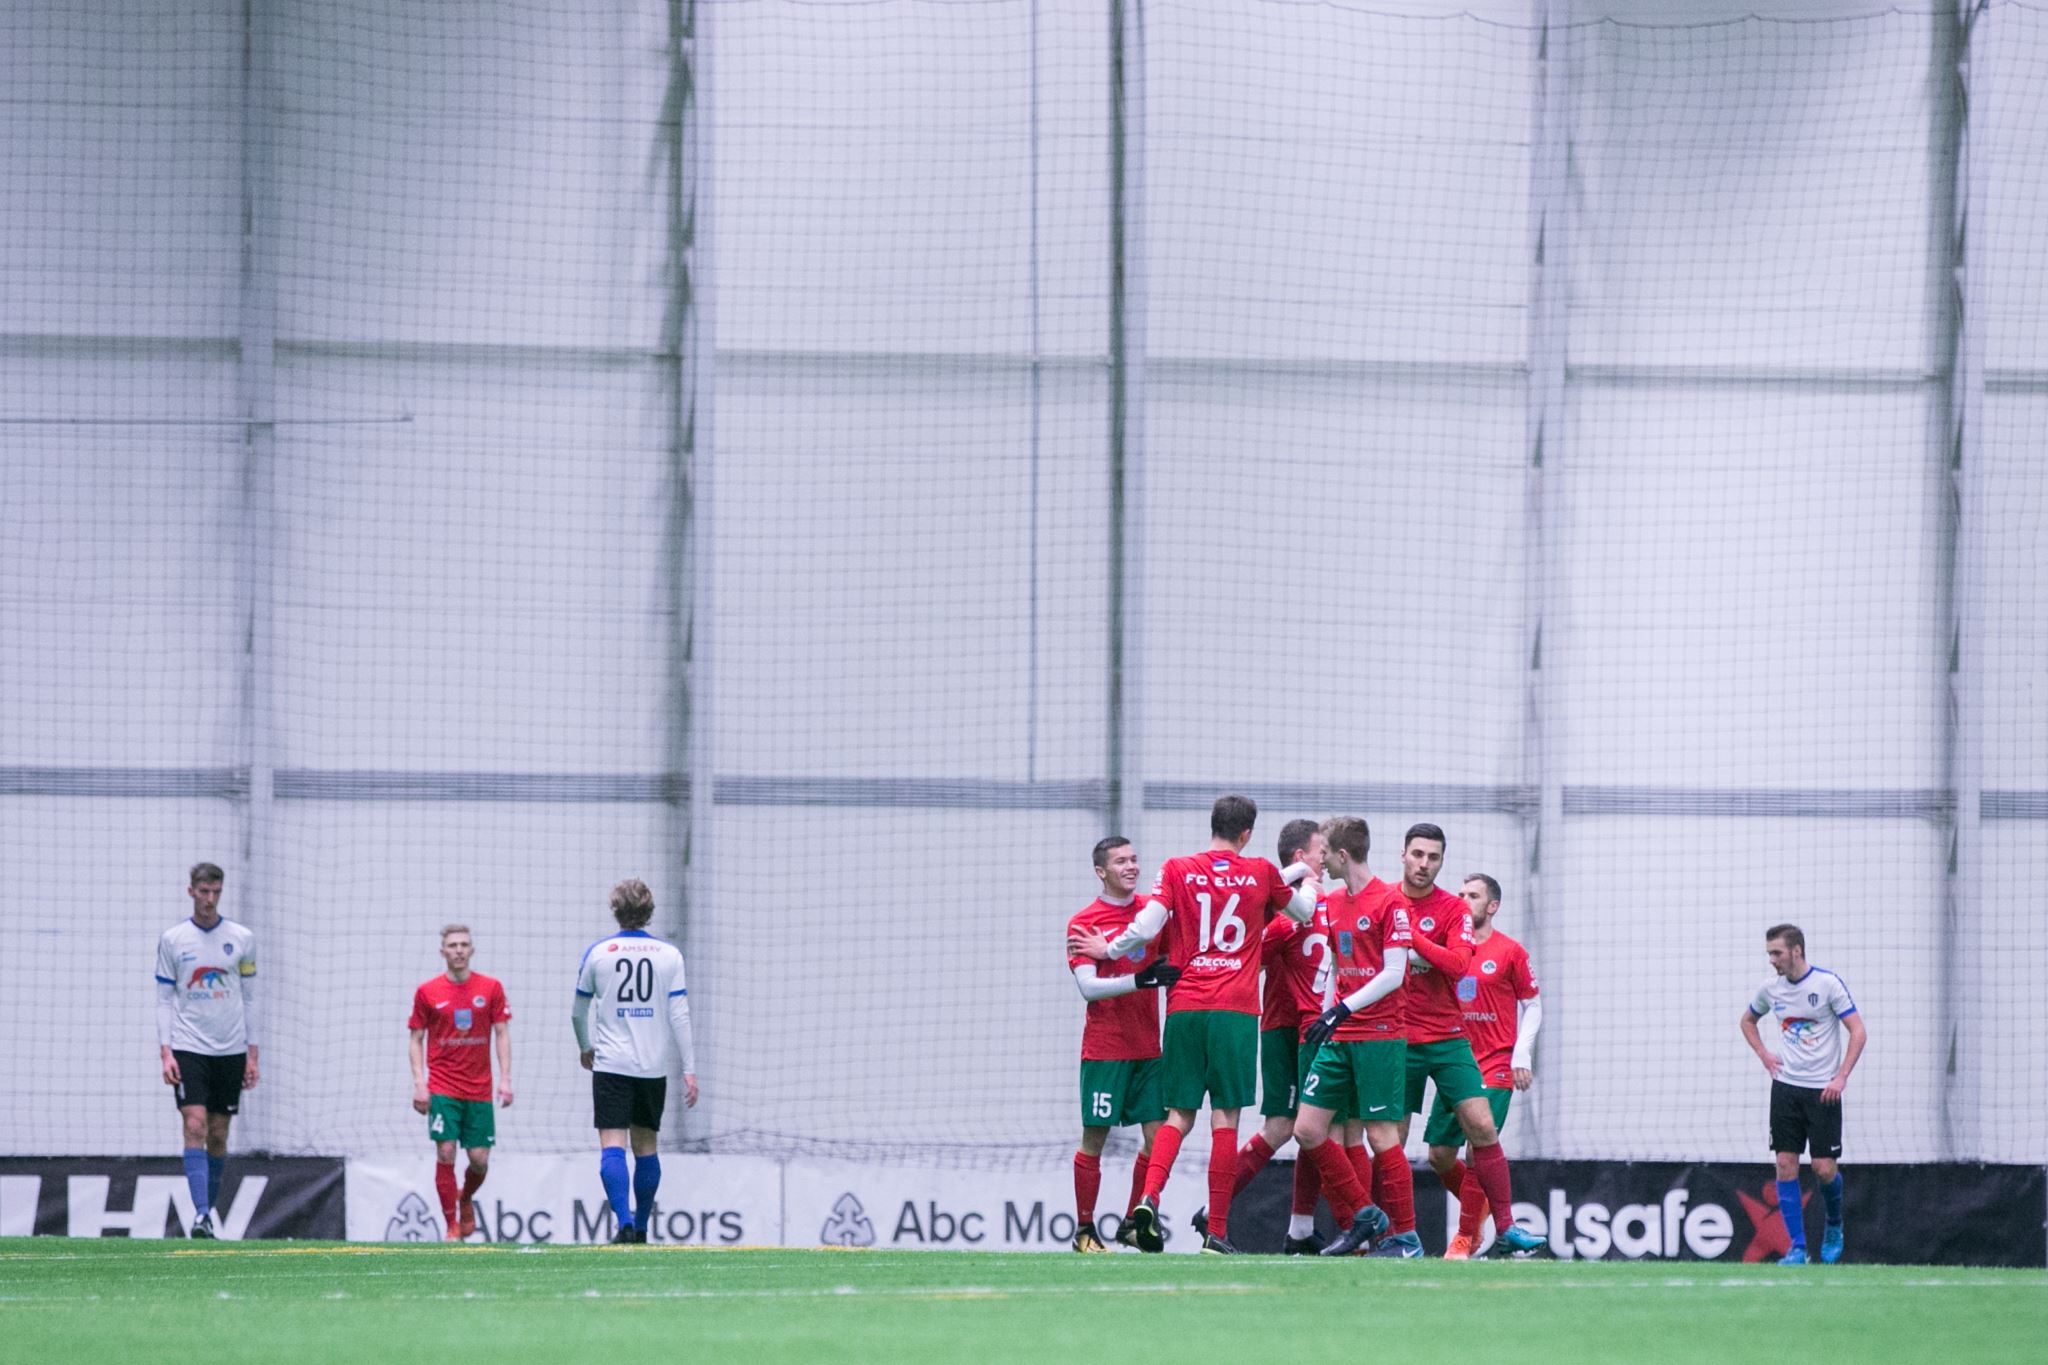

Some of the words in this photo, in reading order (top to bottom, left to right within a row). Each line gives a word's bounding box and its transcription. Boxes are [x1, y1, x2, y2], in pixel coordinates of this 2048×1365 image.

[1186, 873, 1208, 886] FC
[1214, 875, 1257, 887] ELVA
[1196, 892, 1246, 953] 16
[616, 957, 653, 1003] 20
[431, 1113, 445, 1133] 4
[1093, 1092, 1112, 1118] 15
[573, 1199, 743, 1242] Mtors
[892, 1200, 985, 1243] Abc
[1005, 1200, 1172, 1243] Moos
